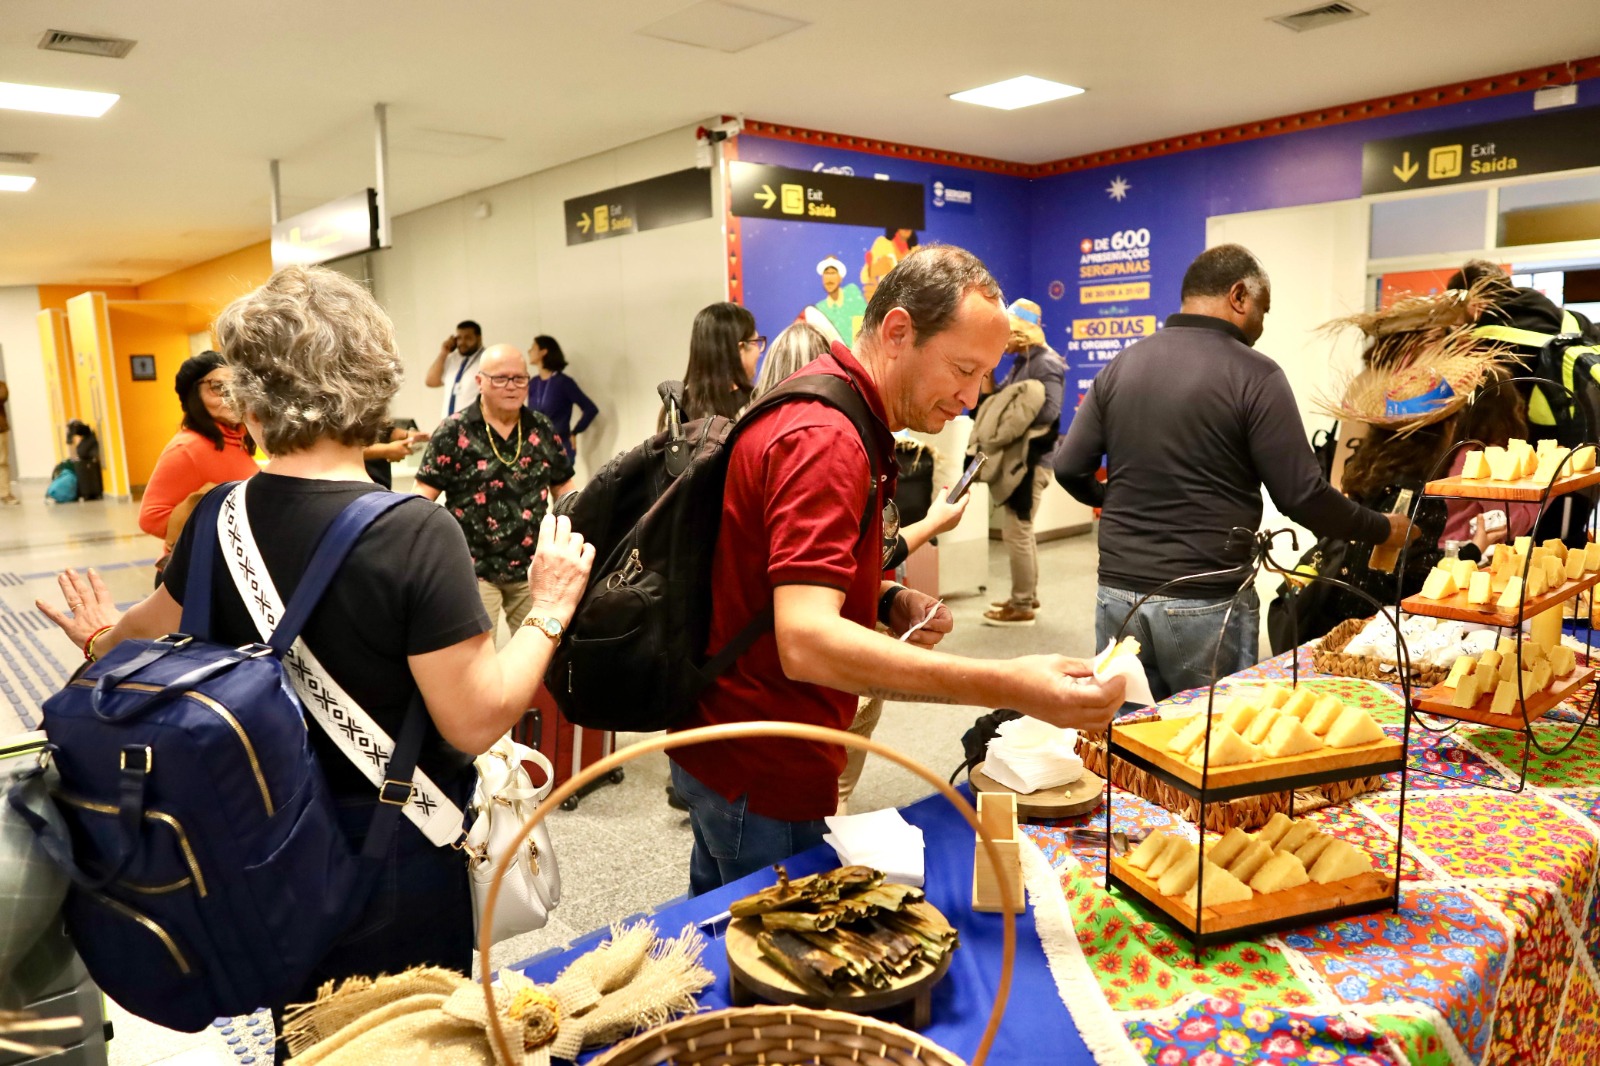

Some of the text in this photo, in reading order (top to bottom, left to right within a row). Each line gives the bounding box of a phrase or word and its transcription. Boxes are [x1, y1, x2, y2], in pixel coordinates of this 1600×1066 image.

[1471, 143, 1496, 157] Exit
[1470, 156, 1517, 174] Saída
[807, 188, 823, 201] Exit
[611, 205, 622, 216] Exit
[1094, 228, 1150, 251] DE 600
[1110, 319, 1144, 335] DIAS
[1068, 341, 1080, 350] DE
